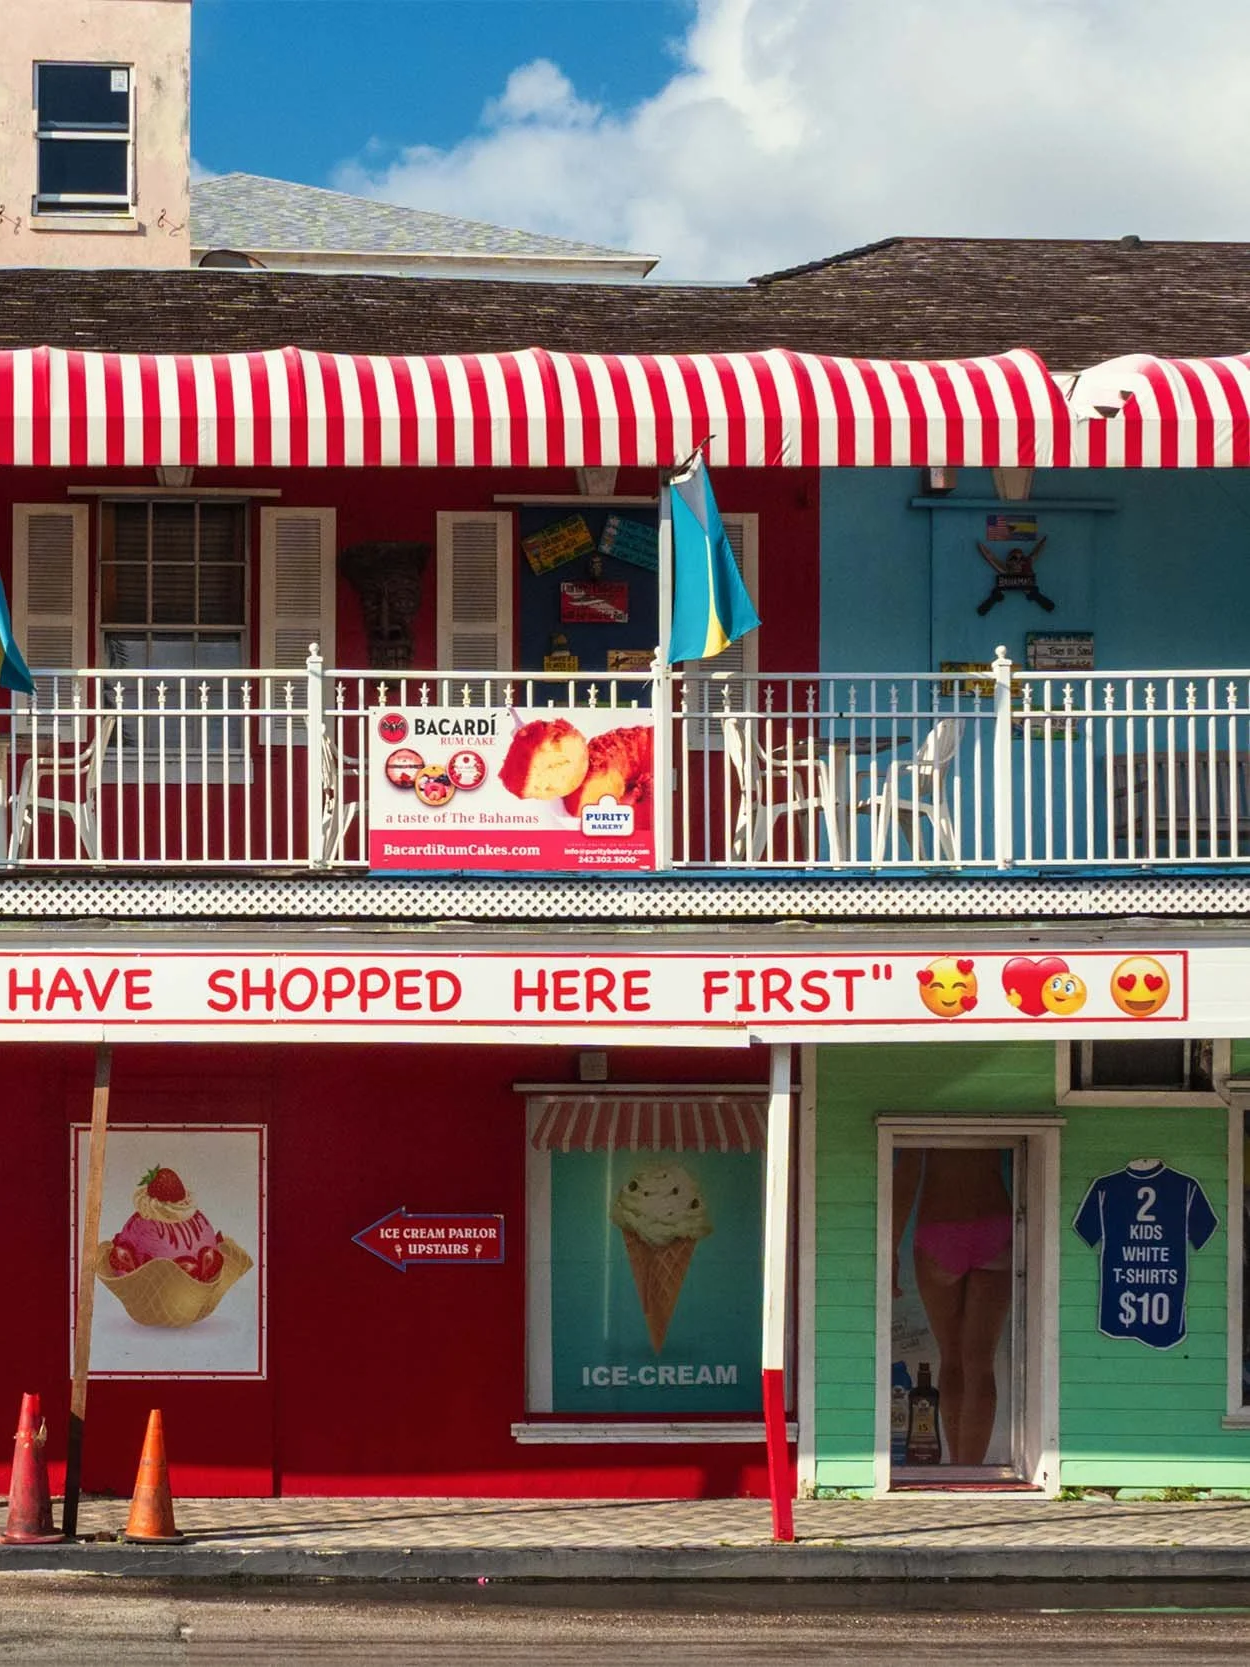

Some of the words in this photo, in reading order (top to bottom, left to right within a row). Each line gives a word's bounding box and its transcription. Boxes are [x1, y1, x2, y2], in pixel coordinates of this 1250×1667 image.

[414, 713, 497, 736] BACARDÍ
[440, 737, 464, 746] RUM
[467, 737, 496, 746] CAKE
[385, 815, 393, 824] a
[397, 813, 430, 824] taste
[433, 812, 448, 824] of
[450, 812, 475, 824] The
[478, 812, 540, 824] Bahamas
[585, 813, 630, 821] PURITY
[383, 844, 541, 856] BacardiRumCakes.com
[8, 967, 153, 1012] HAVE
[207, 968, 463, 1013] SHOPPED
[513, 968, 652, 1013] HERE
[702, 963, 893, 1014] FIRST"
[1136, 1186, 1157, 1222] 2
[380, 1228, 400, 1239] ICE
[402, 1228, 445, 1239] CREAM
[448, 1228, 497, 1239] PARLOR
[1129, 1224, 1163, 1241] KIDS
[408, 1243, 469, 1255] UPSTAIRS
[1122, 1246, 1170, 1263] WHITE
[1113, 1268, 1178, 1285] T-SHIRTS
[1118, 1290, 1170, 1328] $10
[582, 1365, 738, 1386] ICE-CREAM
